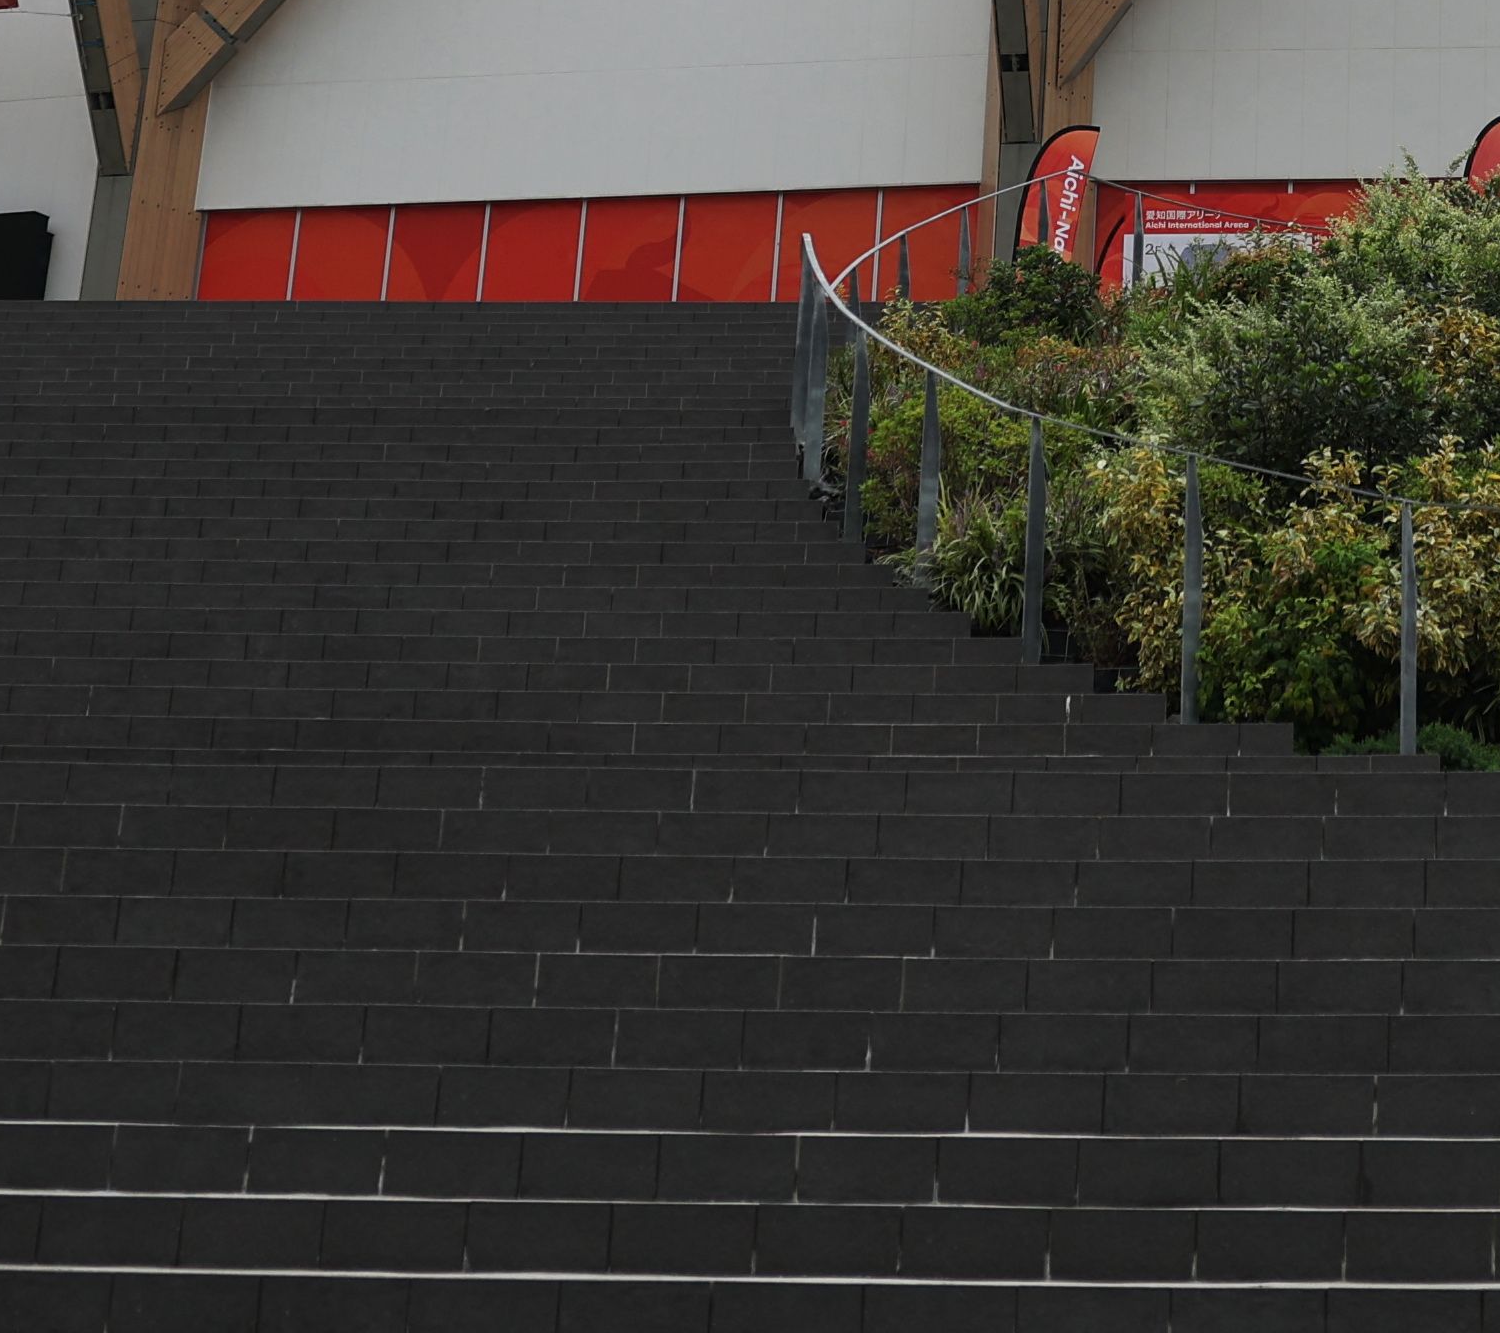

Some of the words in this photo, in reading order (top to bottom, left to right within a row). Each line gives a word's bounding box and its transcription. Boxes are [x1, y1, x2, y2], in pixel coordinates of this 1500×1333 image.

[1054, 154, 1085, 253] Aichi-Na
[1145, 221, 1166, 229] Aichi
[1167, 220, 1222, 229] International
[1223, 221, 1250, 229] Arena
